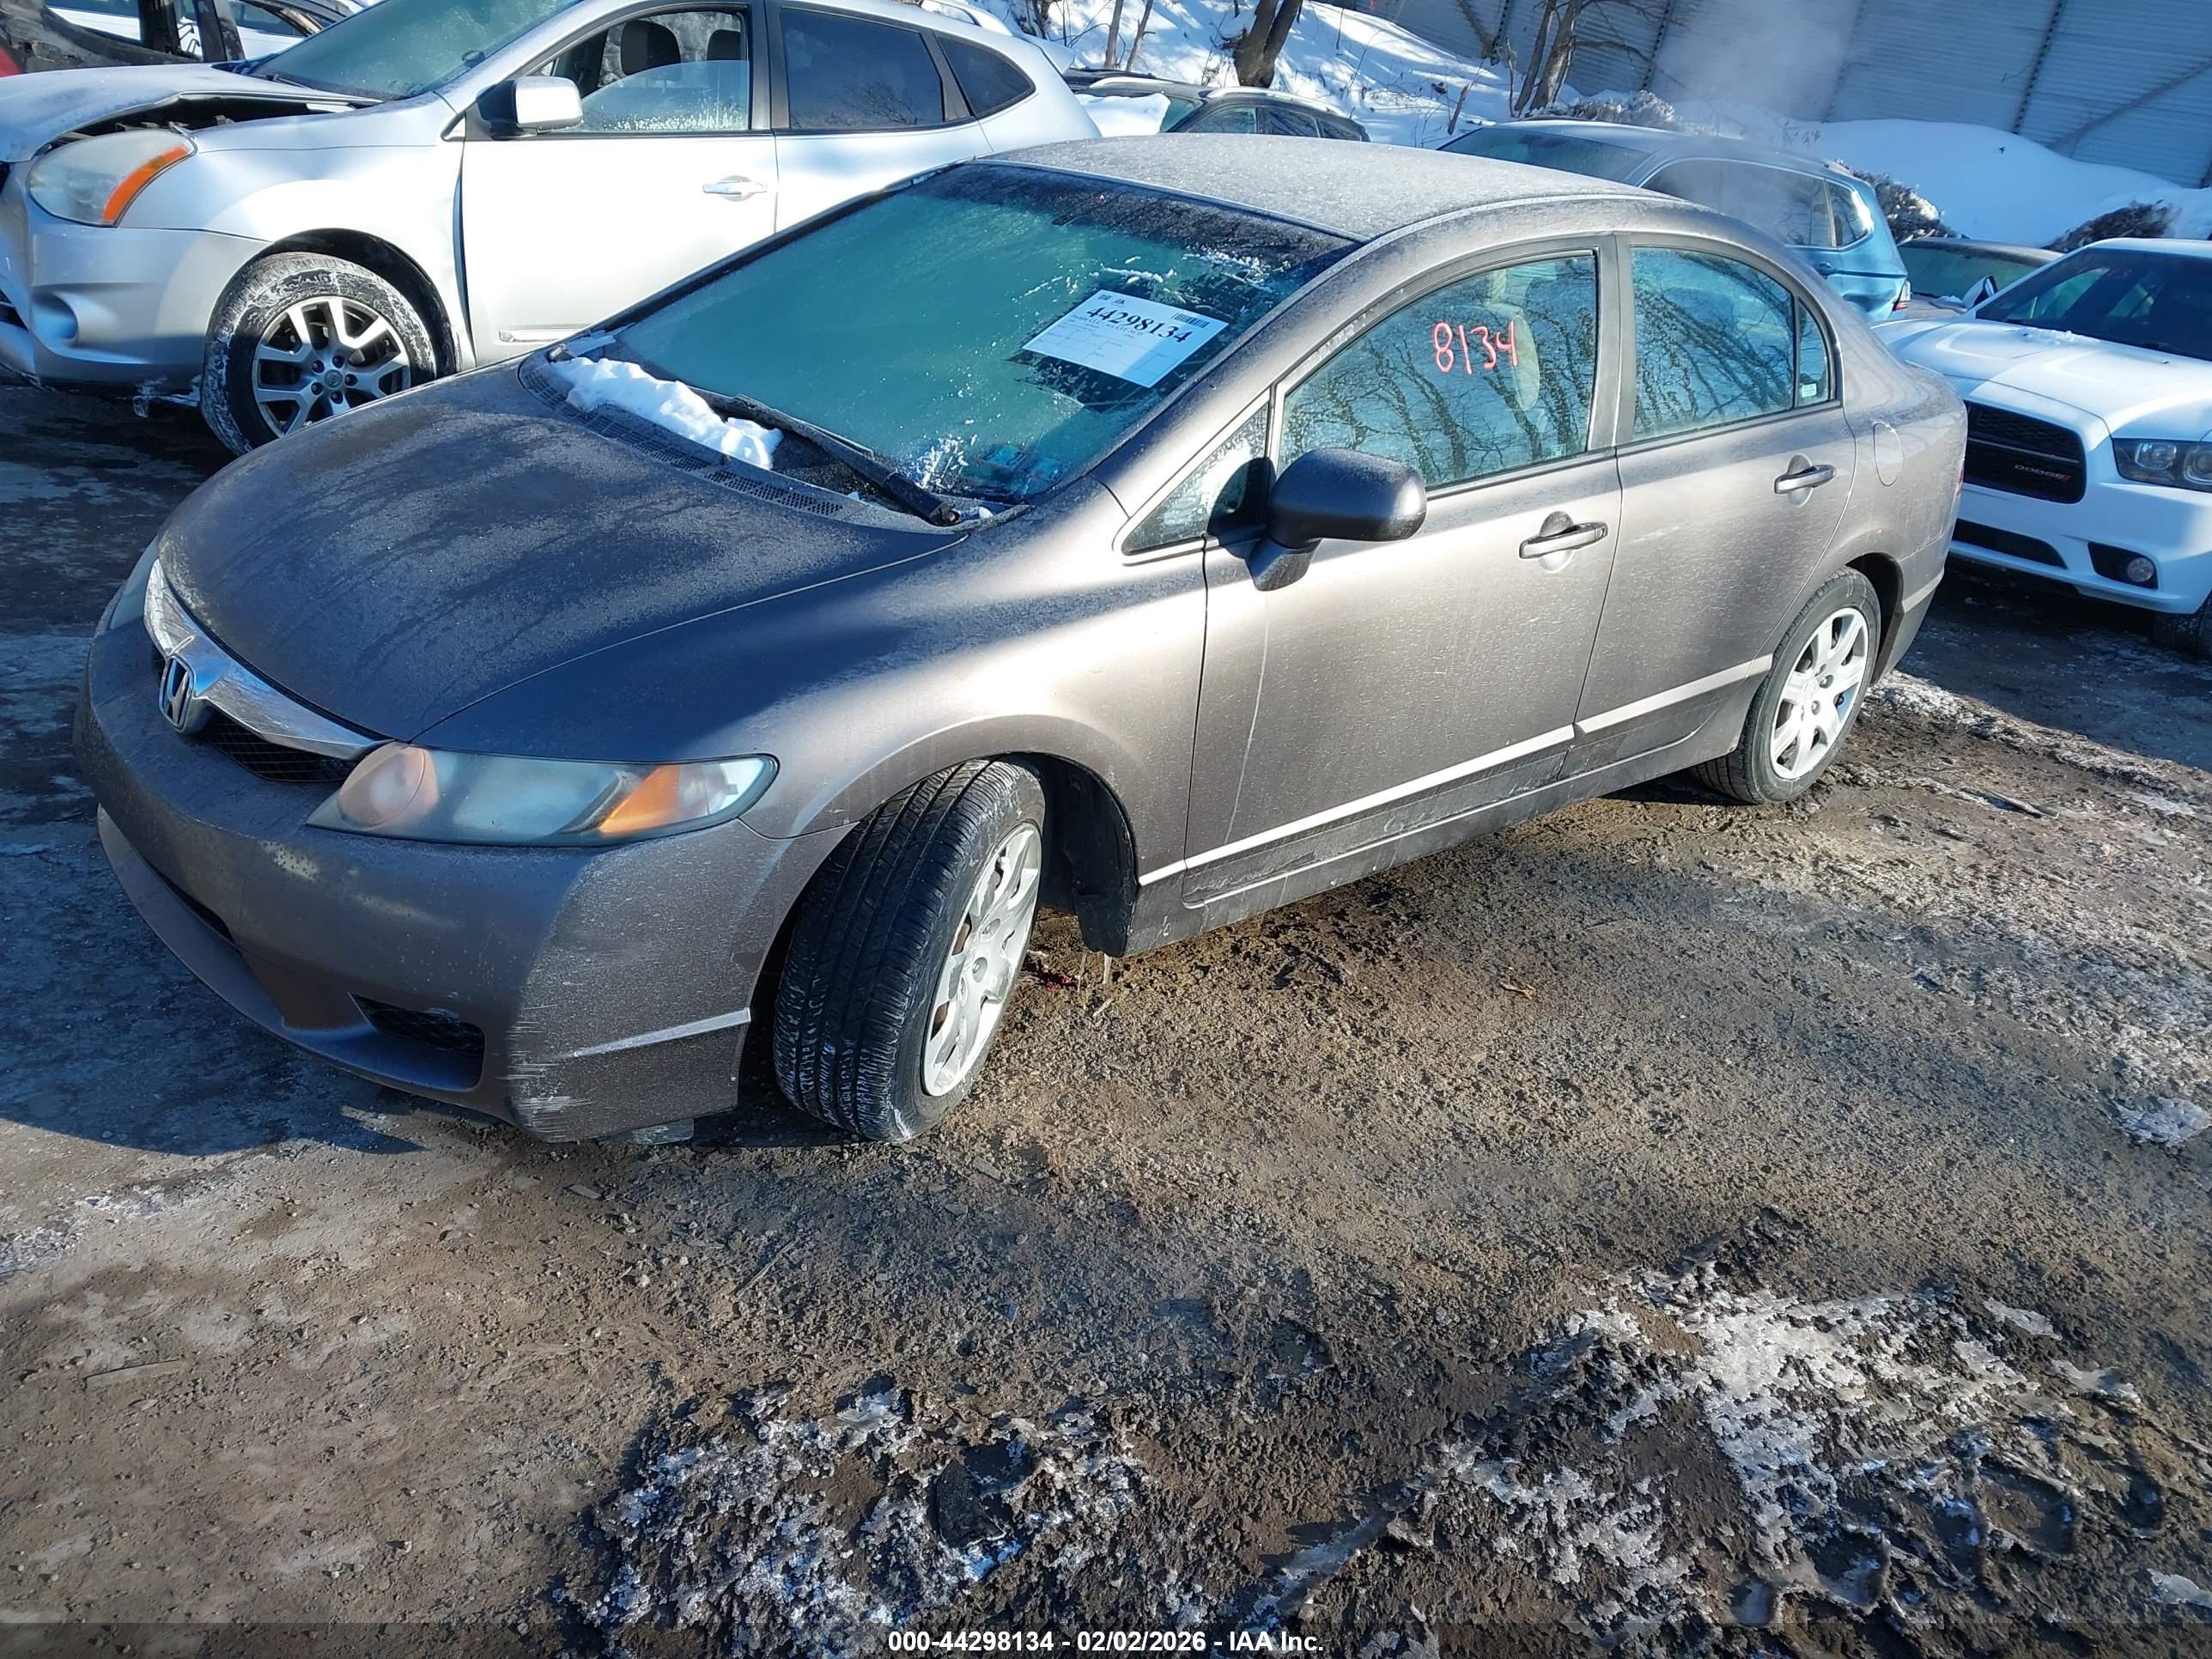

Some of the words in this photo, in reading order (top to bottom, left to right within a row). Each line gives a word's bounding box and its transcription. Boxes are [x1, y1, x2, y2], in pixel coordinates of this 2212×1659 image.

[1085, 306, 1194, 343] 44298134
[1433, 320, 1518, 374] 8134
[2014, 465, 2065, 479] DODGE
